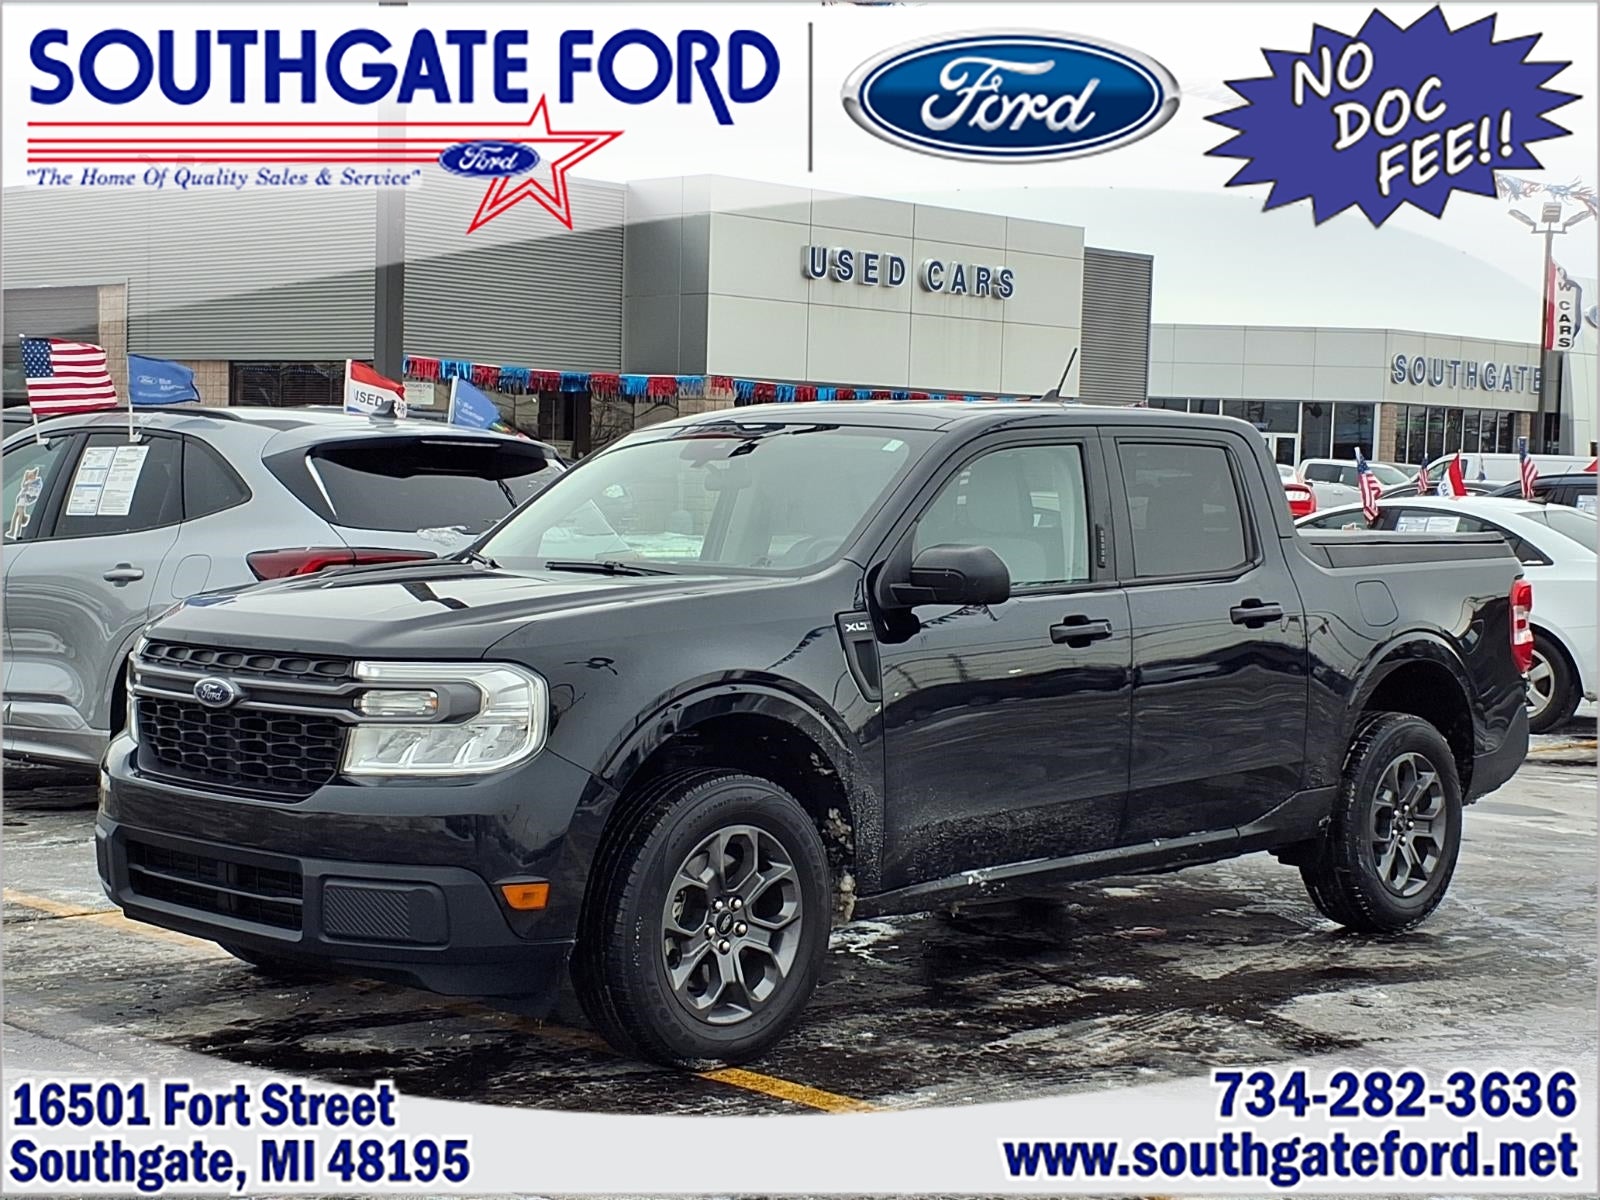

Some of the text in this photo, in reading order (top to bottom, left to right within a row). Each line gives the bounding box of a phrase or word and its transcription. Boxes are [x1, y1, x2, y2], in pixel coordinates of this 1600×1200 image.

[805, 245, 1015, 300] USED CARS
[1558, 300, 1572, 347] CARS
[844, 622, 868, 632] XLT
[200, 683, 223, 700] Ford
